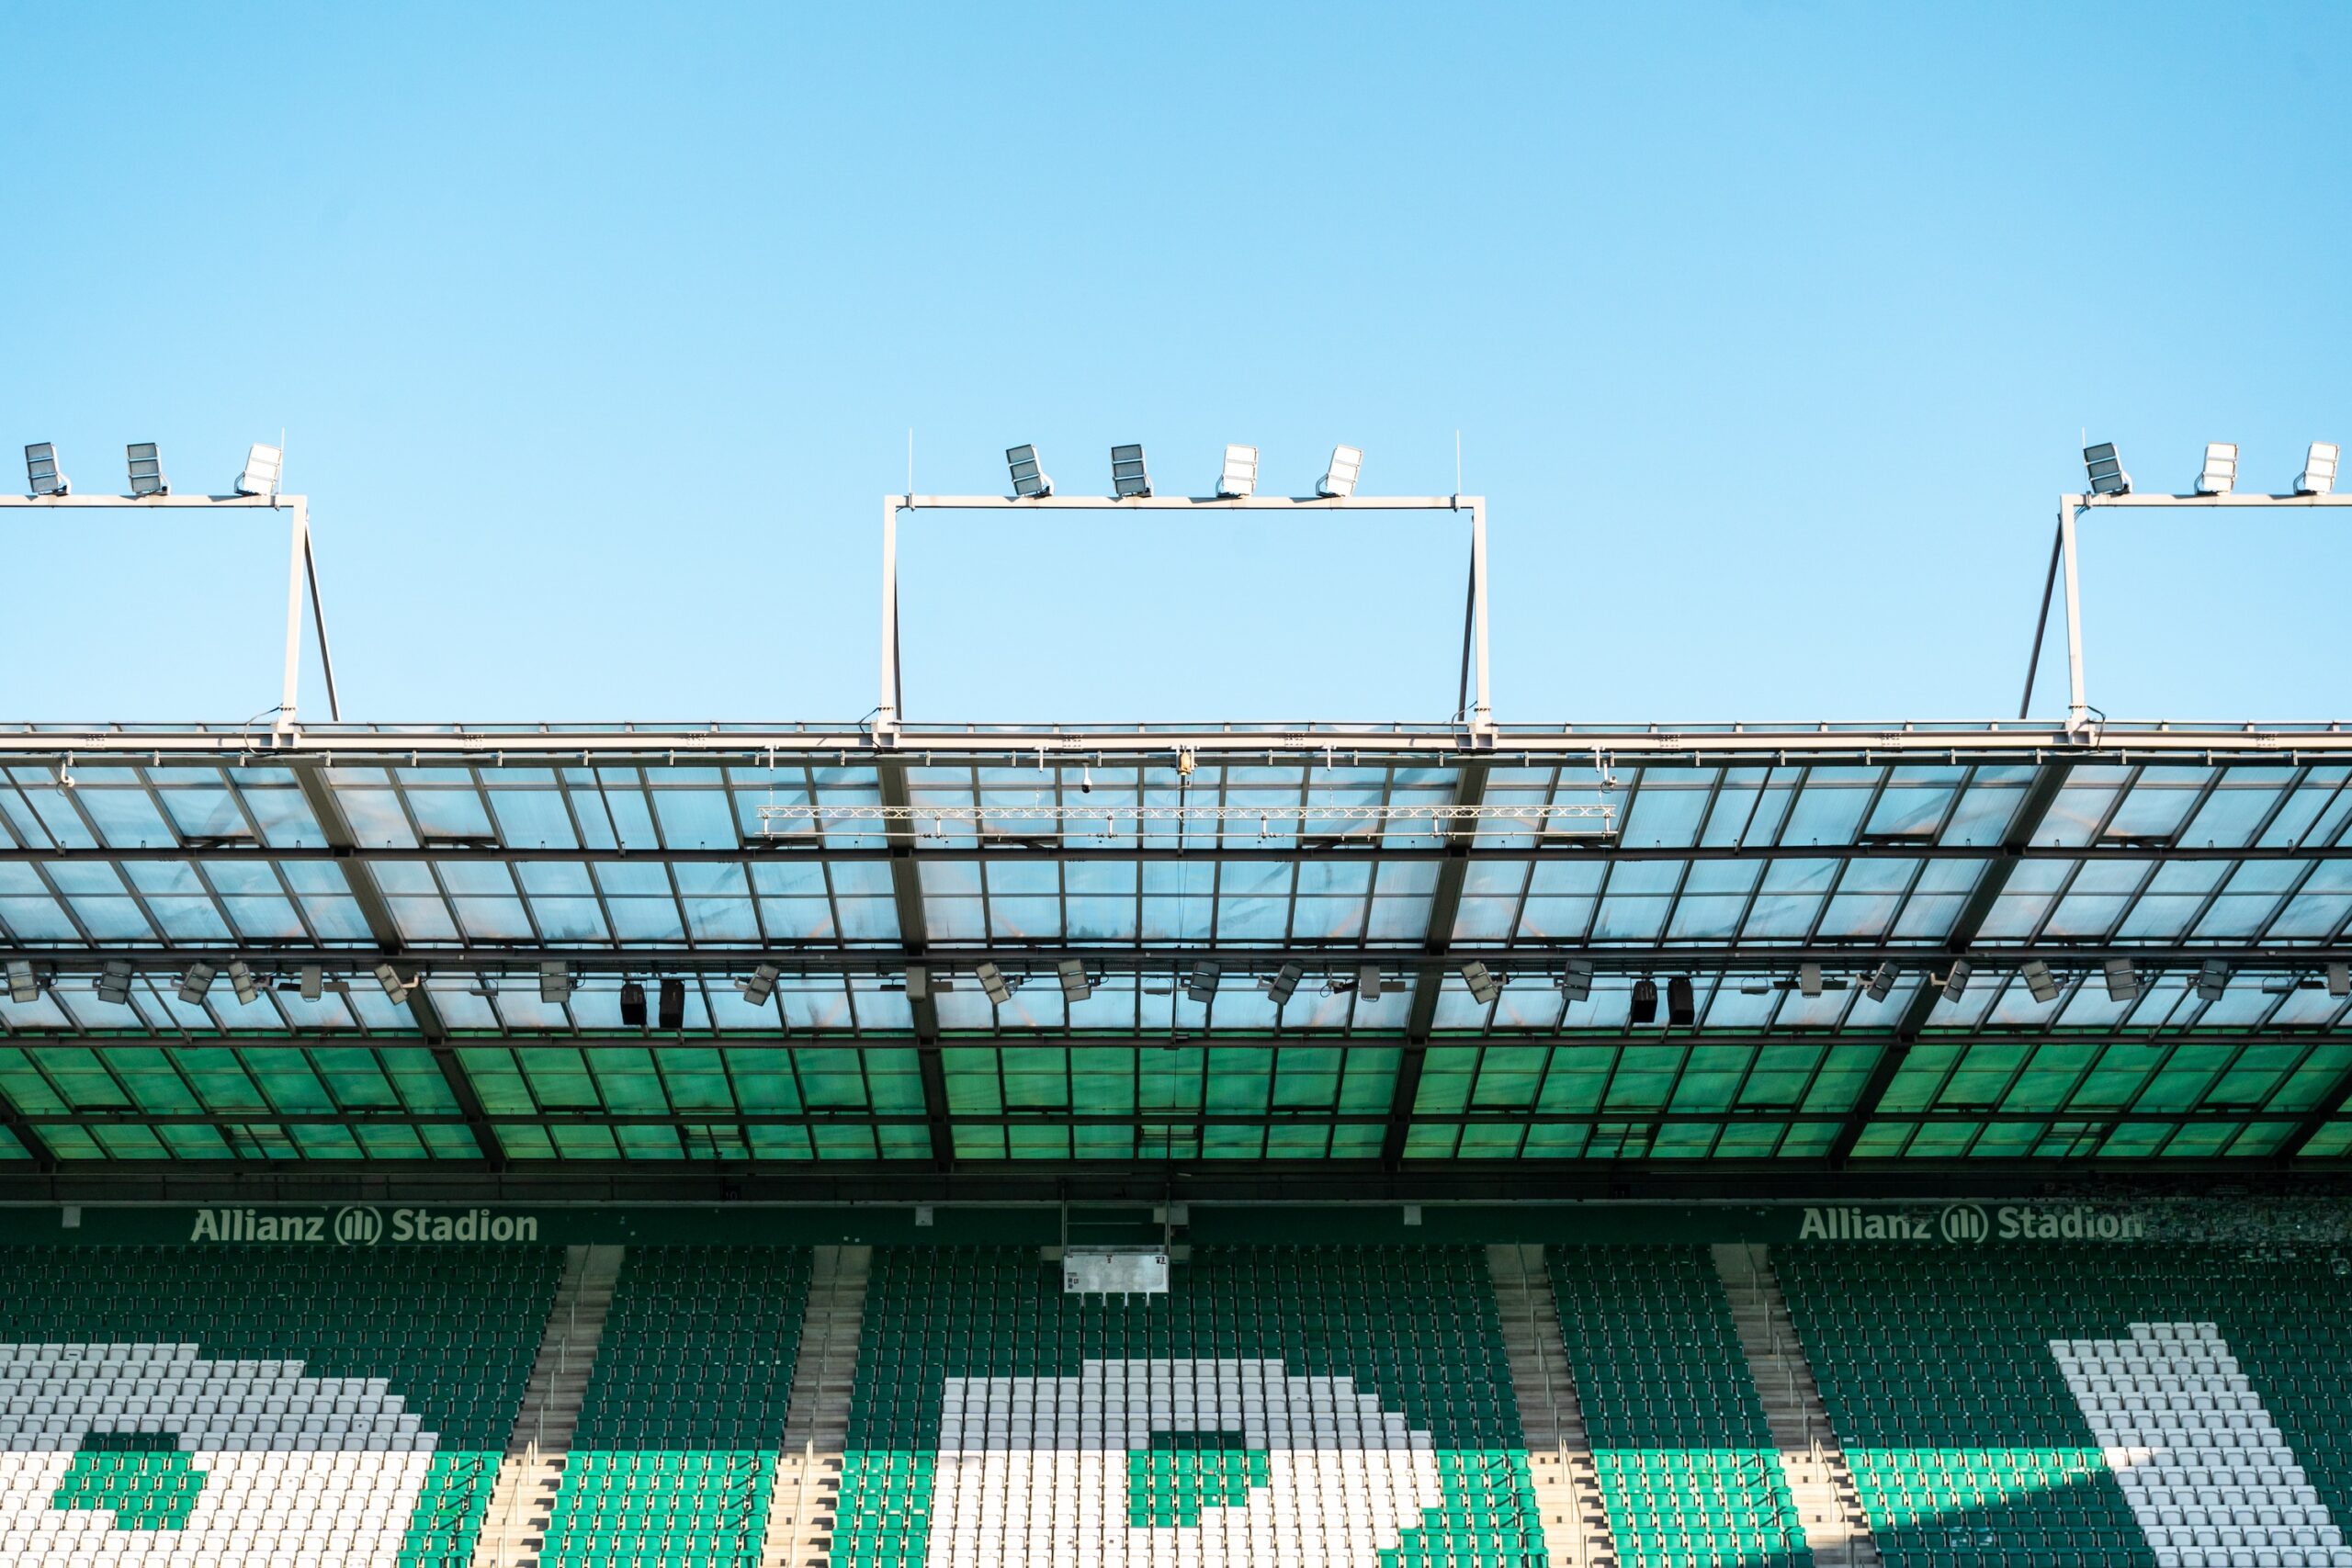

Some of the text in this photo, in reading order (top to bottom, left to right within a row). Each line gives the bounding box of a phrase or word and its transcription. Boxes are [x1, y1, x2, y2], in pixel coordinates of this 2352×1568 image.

[191, 1209, 537, 1241] Allianz Stadion
[1799, 1208, 2143, 1240] Allianz Stadion
